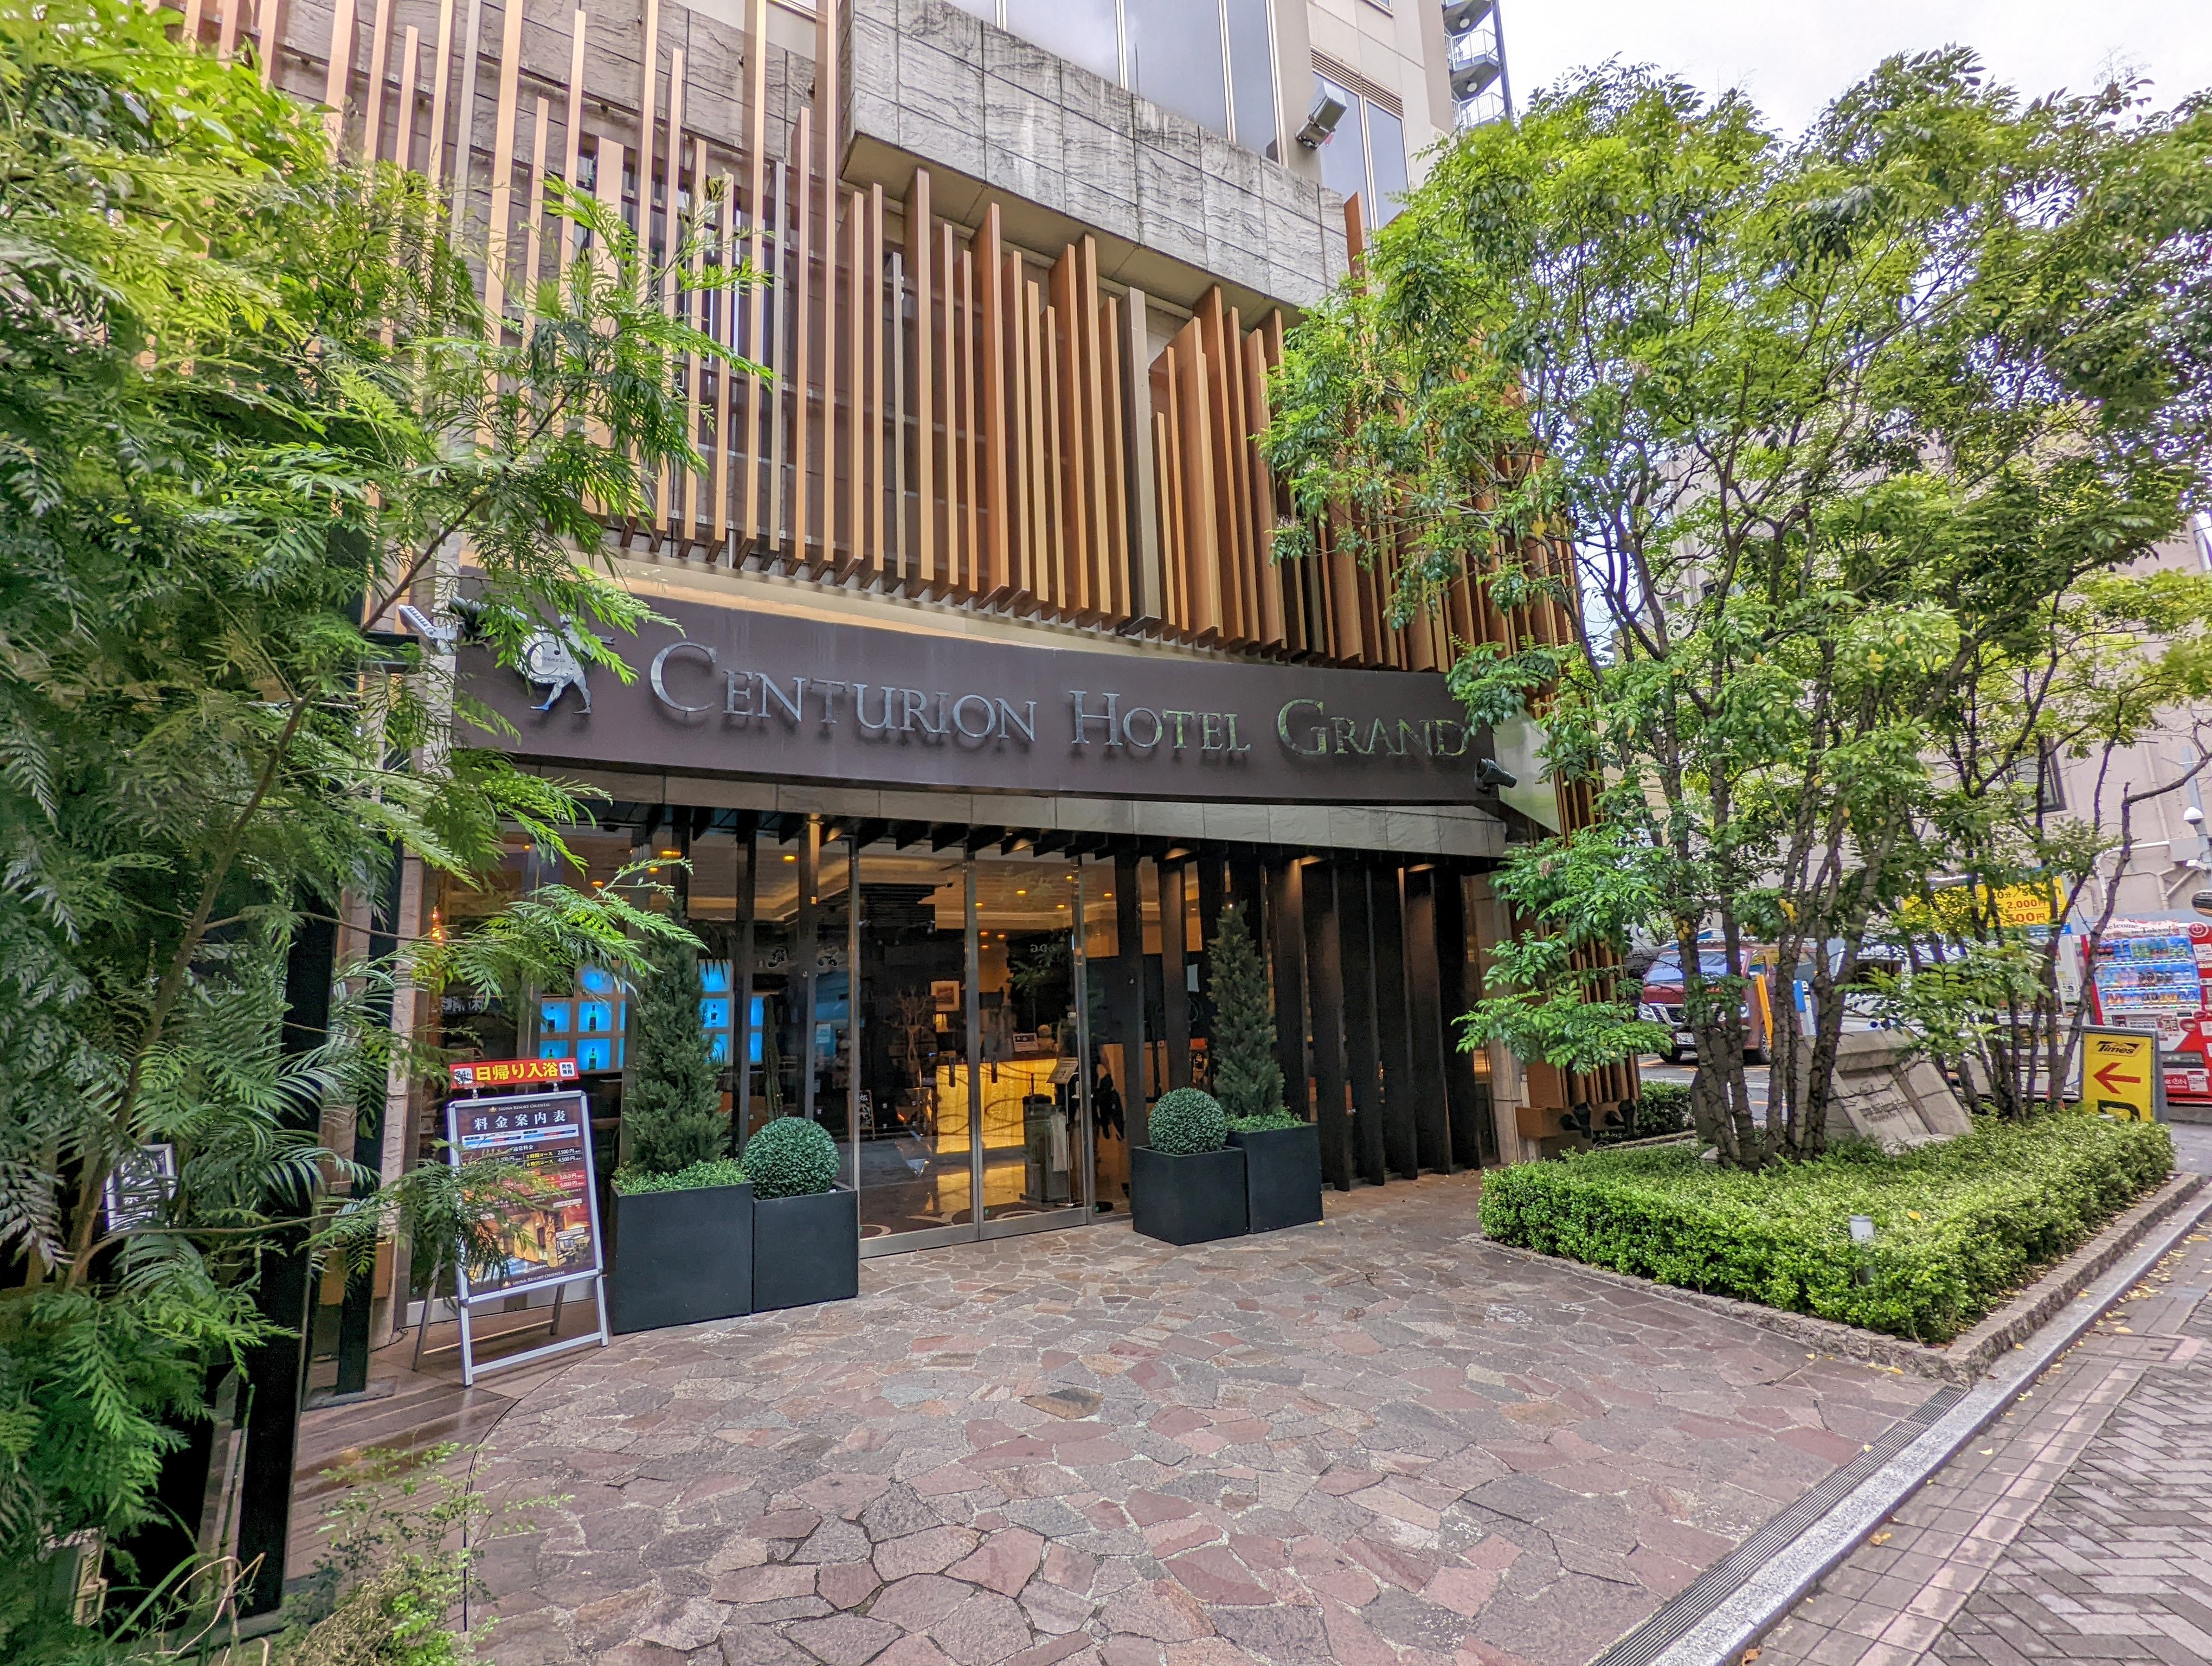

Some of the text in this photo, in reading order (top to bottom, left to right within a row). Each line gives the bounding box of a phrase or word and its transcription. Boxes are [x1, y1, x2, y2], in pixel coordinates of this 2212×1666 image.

[651, 642, 1467, 757] CENTURION HOTEL GRAND
[2098, 1043, 2135, 1054] Times
[475, 1062, 559, 1081] 日帰り入浴
[474, 1110, 566, 1131] 料金案内表
